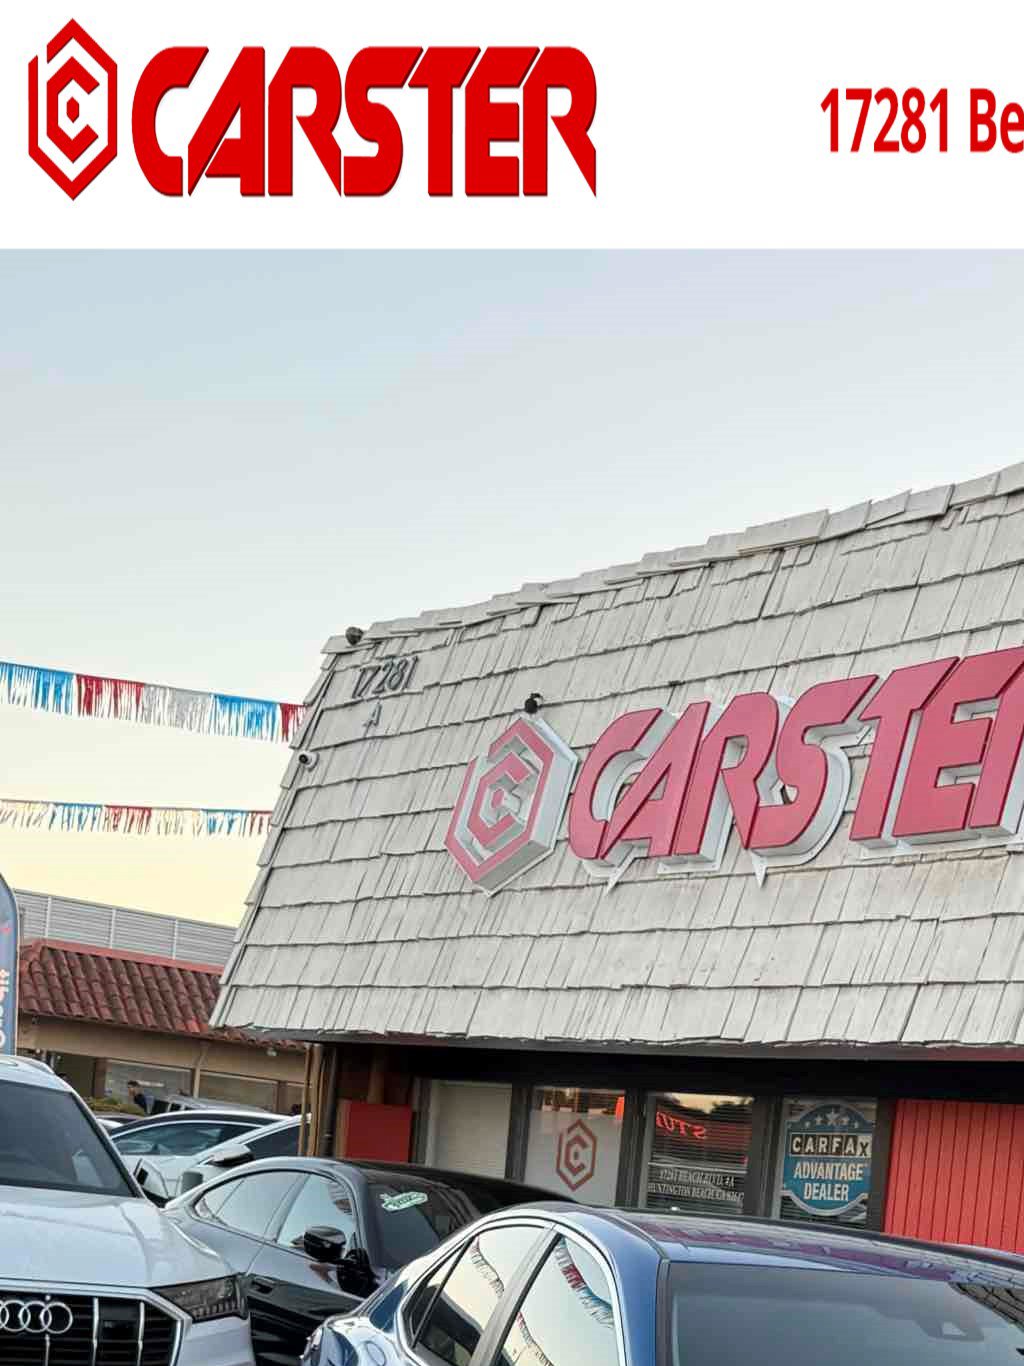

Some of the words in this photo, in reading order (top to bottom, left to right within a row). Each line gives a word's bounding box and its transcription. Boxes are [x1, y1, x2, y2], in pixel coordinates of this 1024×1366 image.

[351, 655, 419, 699] 17281
[792, 1136, 870, 1157] CARFAX
[793, 1161, 865, 1181] ADVANTAGE
[803, 1182, 849, 1202] DEALER
